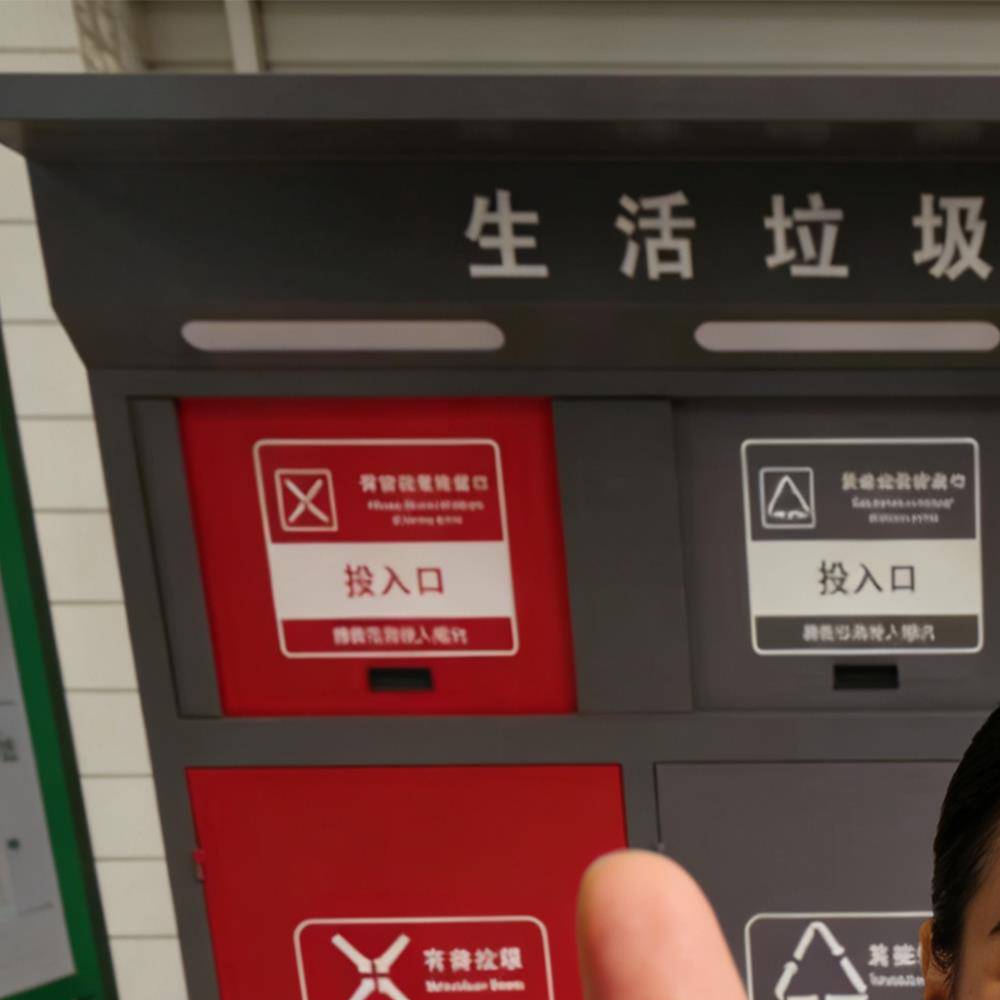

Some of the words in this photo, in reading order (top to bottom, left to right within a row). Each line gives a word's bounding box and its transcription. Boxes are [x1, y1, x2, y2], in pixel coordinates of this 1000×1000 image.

[344, 564, 444, 598] 投入口
[818, 560, 916, 595] 投入口
